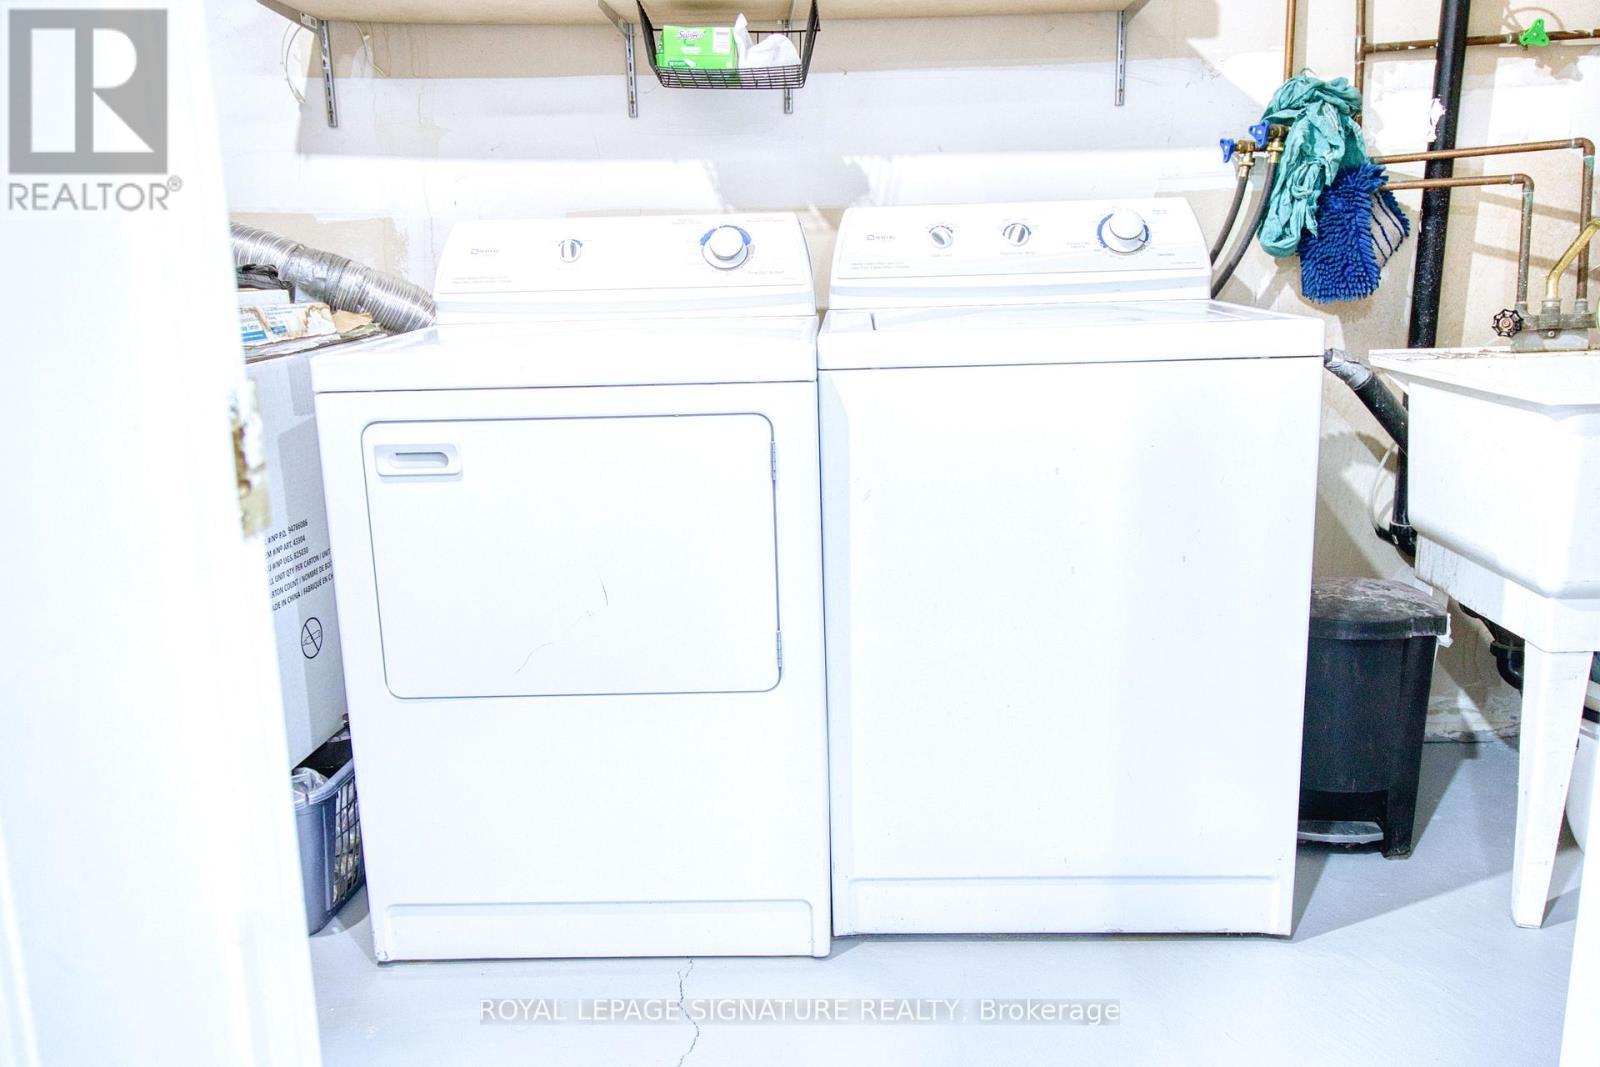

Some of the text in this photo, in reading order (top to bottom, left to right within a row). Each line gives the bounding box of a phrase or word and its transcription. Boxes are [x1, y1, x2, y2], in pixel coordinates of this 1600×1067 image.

[286, 566, 295, 577] QTY
[295, 562, 303, 573] PER
[303, 555, 320, 568] CARTON
[271, 586, 284, 598] RTON
[284, 578, 299, 592] COUNT
[318, 564, 325, 573] DE
[281, 598, 287, 607] IN
[287, 591, 301, 604] CHINA
